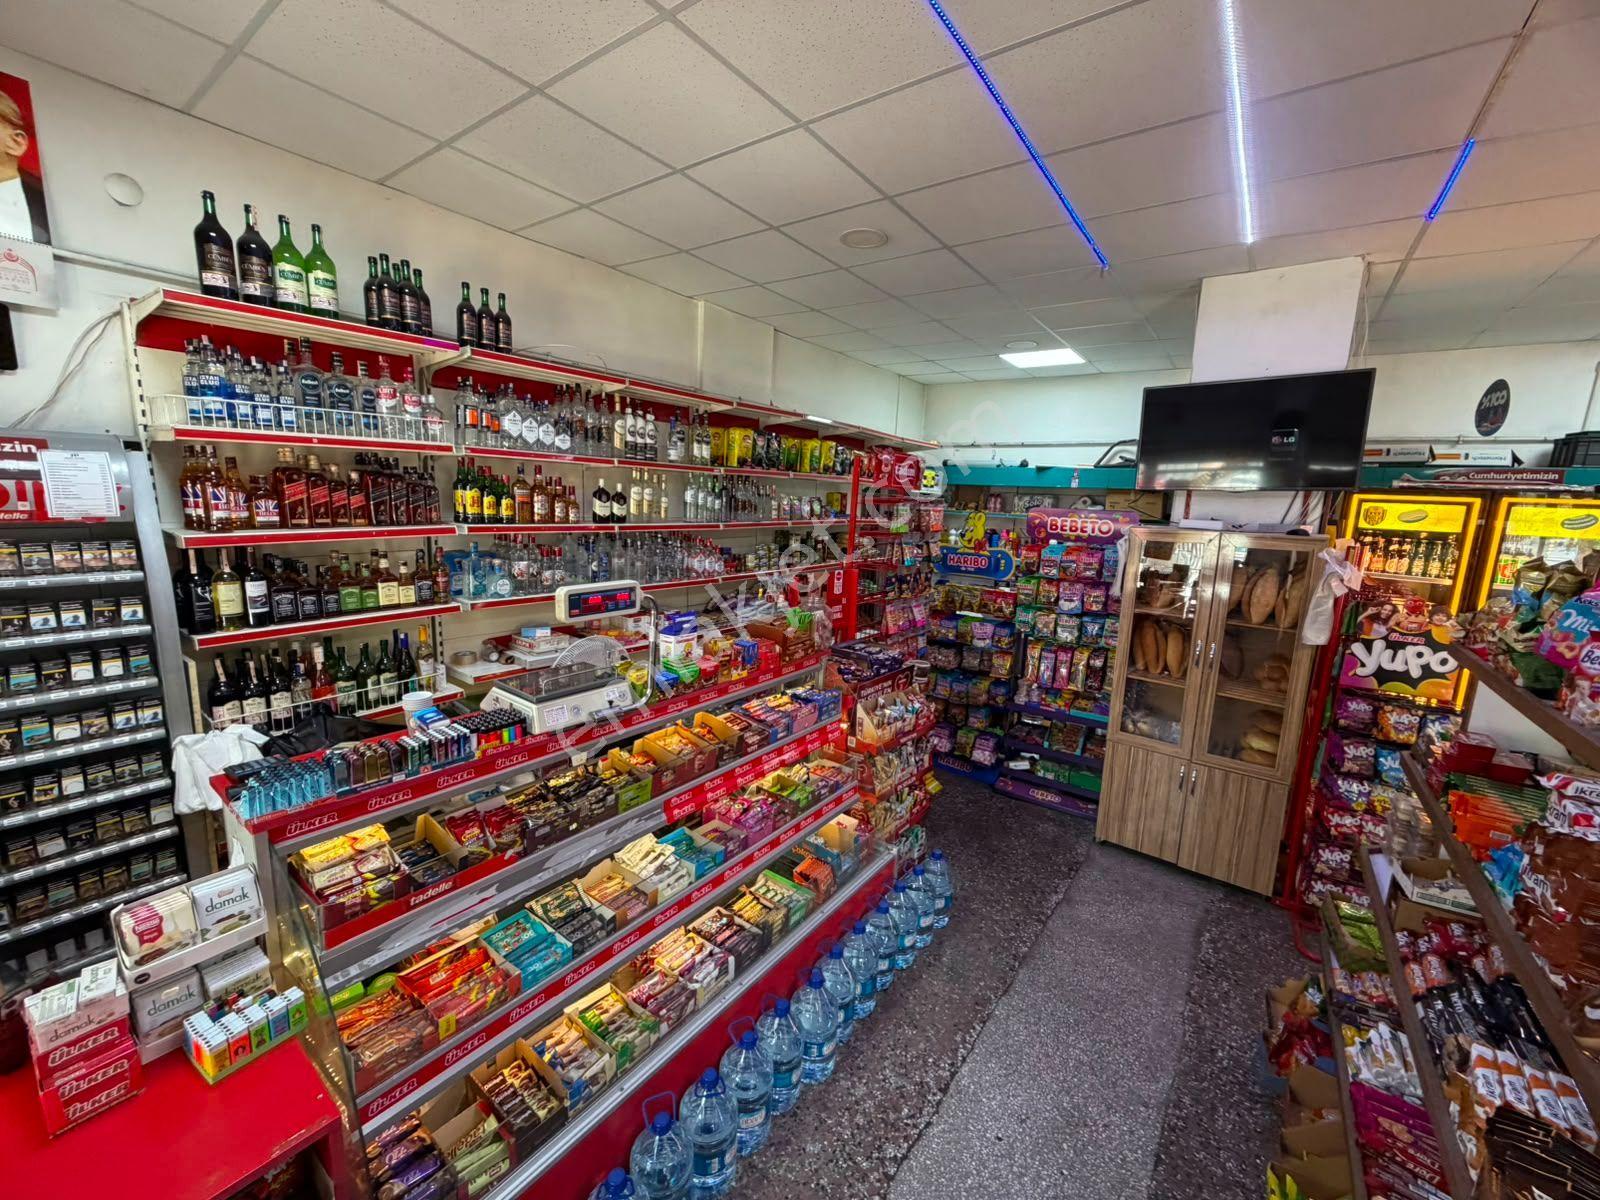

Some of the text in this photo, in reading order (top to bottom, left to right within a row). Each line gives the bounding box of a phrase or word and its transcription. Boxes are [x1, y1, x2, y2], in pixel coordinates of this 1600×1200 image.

[1469, 472, 1559, 482] Cumhuriyetimizin
[1048, 517, 1114, 536] BEBETO
[947, 553, 988, 568] HARIBO
[495, 752, 529, 769] ÜLKER
[437, 768, 475, 789] ÜLKER
[368, 789, 412, 811] ÜLKER
[1029, 788, 1062, 802] BEBETO
[287, 812, 338, 837] ÜLKER
[205, 886, 250, 913] damak
[410, 880, 453, 907] tadelle
[564, 961, 597, 987] ÜLKER
[147, 986, 196, 1016] damak
[509, 994, 546, 1023] ÜLKER
[49, 1014, 96, 1042] damak
[48, 1027, 120, 1067] ÜLKER
[444, 1032, 487, 1067] ÜLKER
[59, 1059, 130, 1101] ÜLKER
[64, 1080, 130, 1120] ÜLKER
[368, 1079, 418, 1116] ÜLKER
